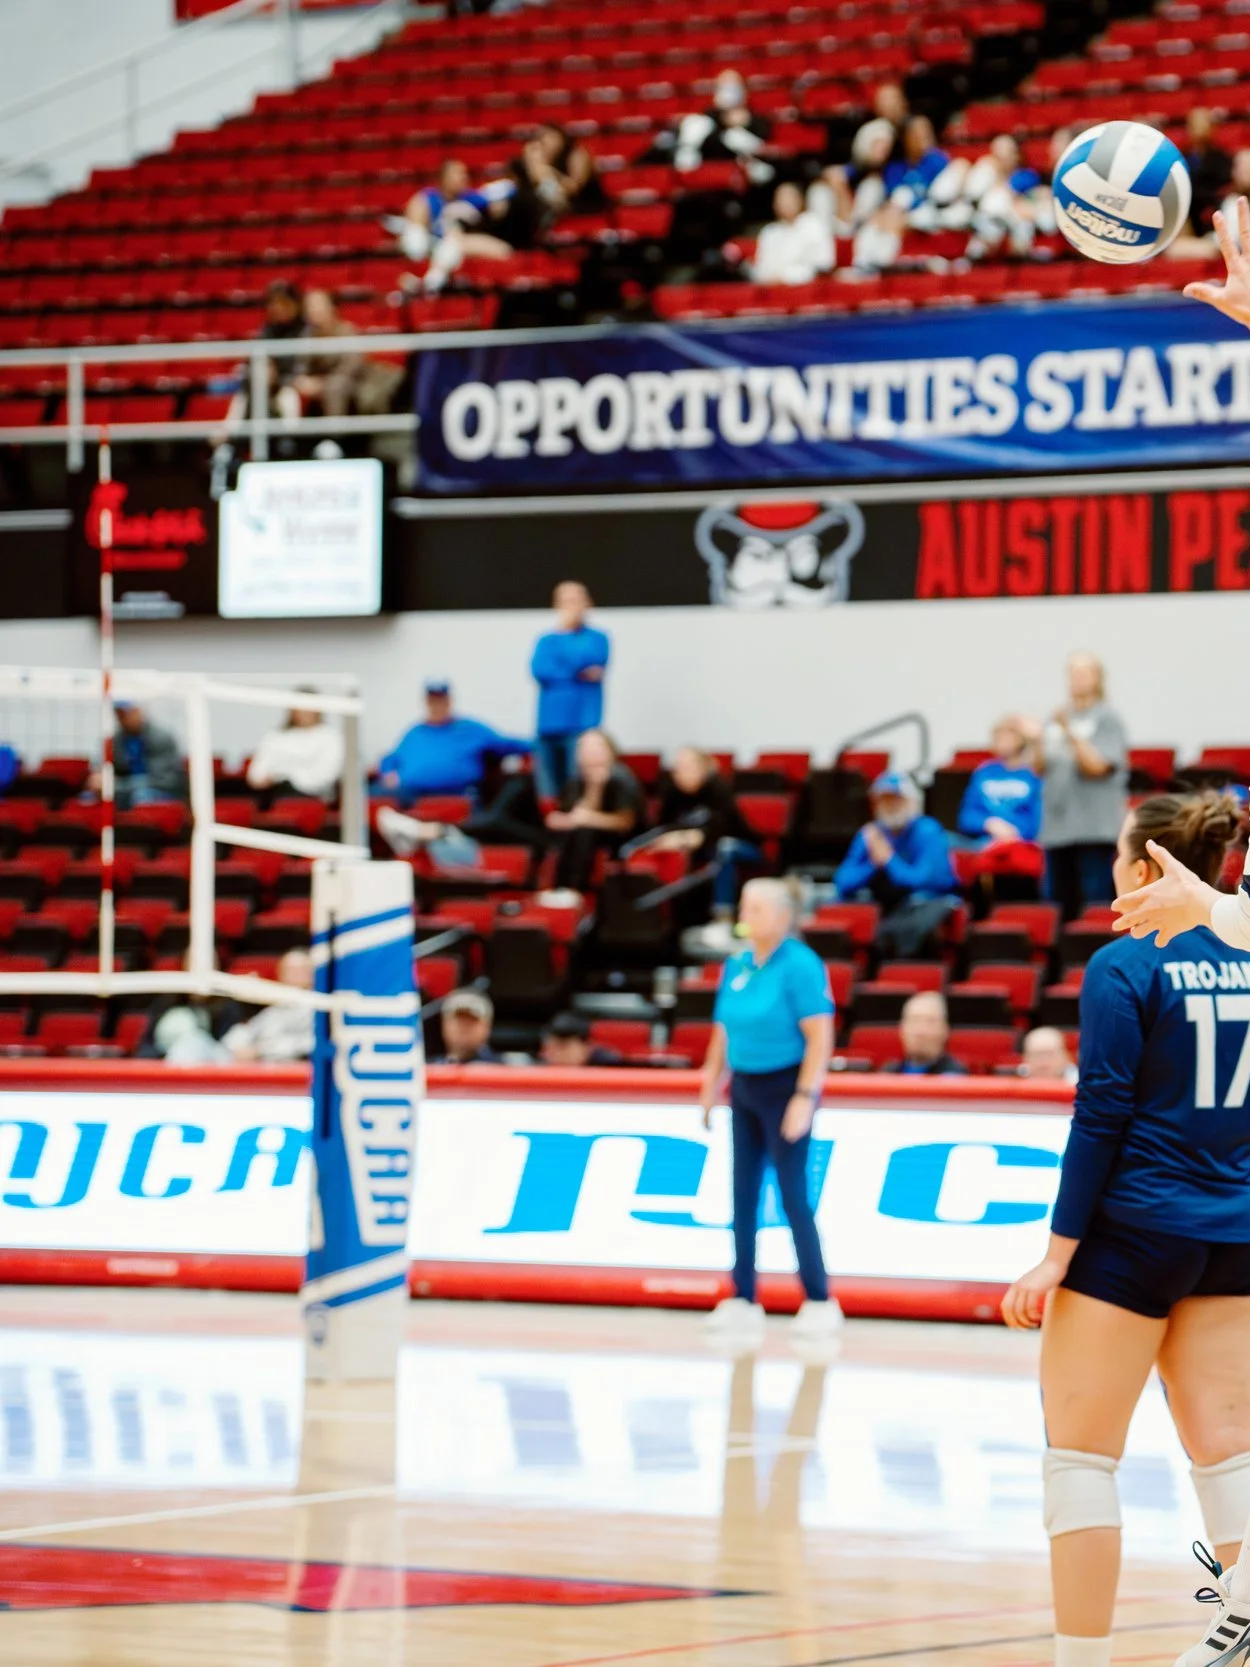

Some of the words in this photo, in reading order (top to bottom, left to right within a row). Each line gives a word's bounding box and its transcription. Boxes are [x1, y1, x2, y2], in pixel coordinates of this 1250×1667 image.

[1066, 202, 1142, 243] molten
[441, 354, 1018, 462] OPPORTUNITIES
[916, 493, 1152, 600] AUSTIN
